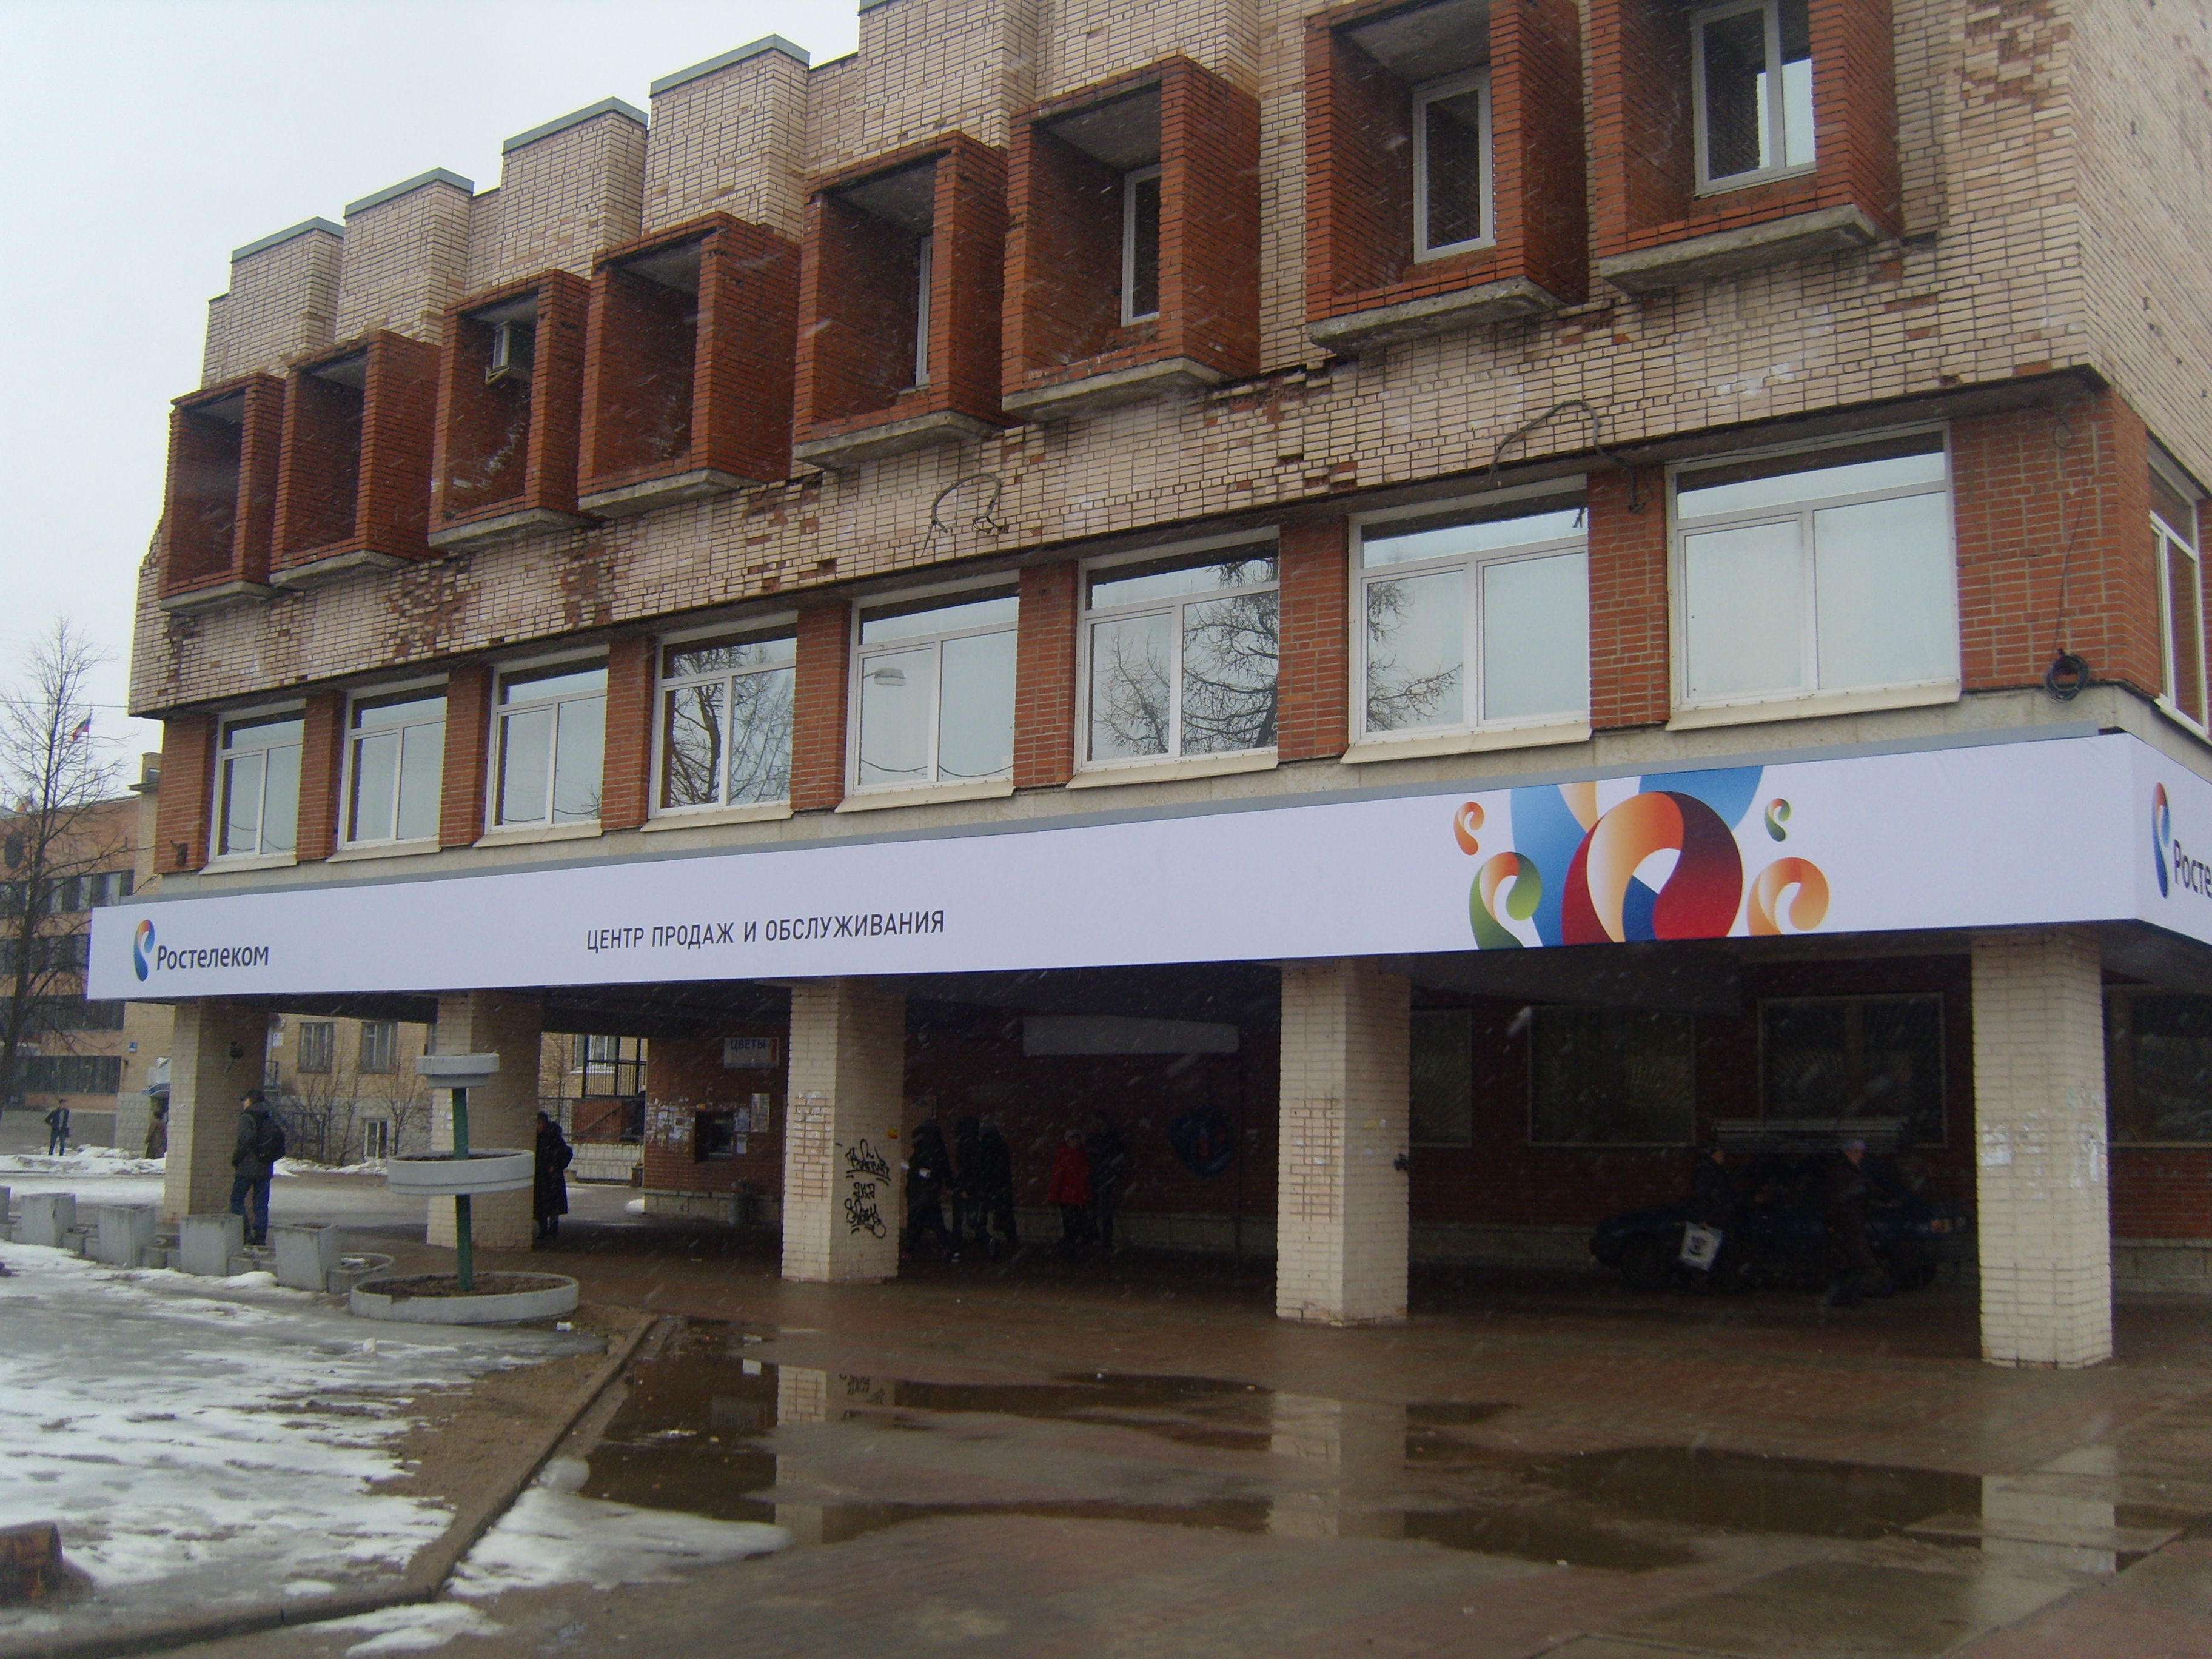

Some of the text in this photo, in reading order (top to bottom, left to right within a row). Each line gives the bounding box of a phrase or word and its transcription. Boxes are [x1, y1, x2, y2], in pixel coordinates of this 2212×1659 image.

[2173, 839, 2212, 899] Росте
[586, 910, 945, 954] ЦЕНТР ПРОДАЖ И ОБСЛУЖИВАНИЯ
[156, 945, 269, 970] Ростелеком
[730, 1039, 766, 1051] ЦВЕТЫ
